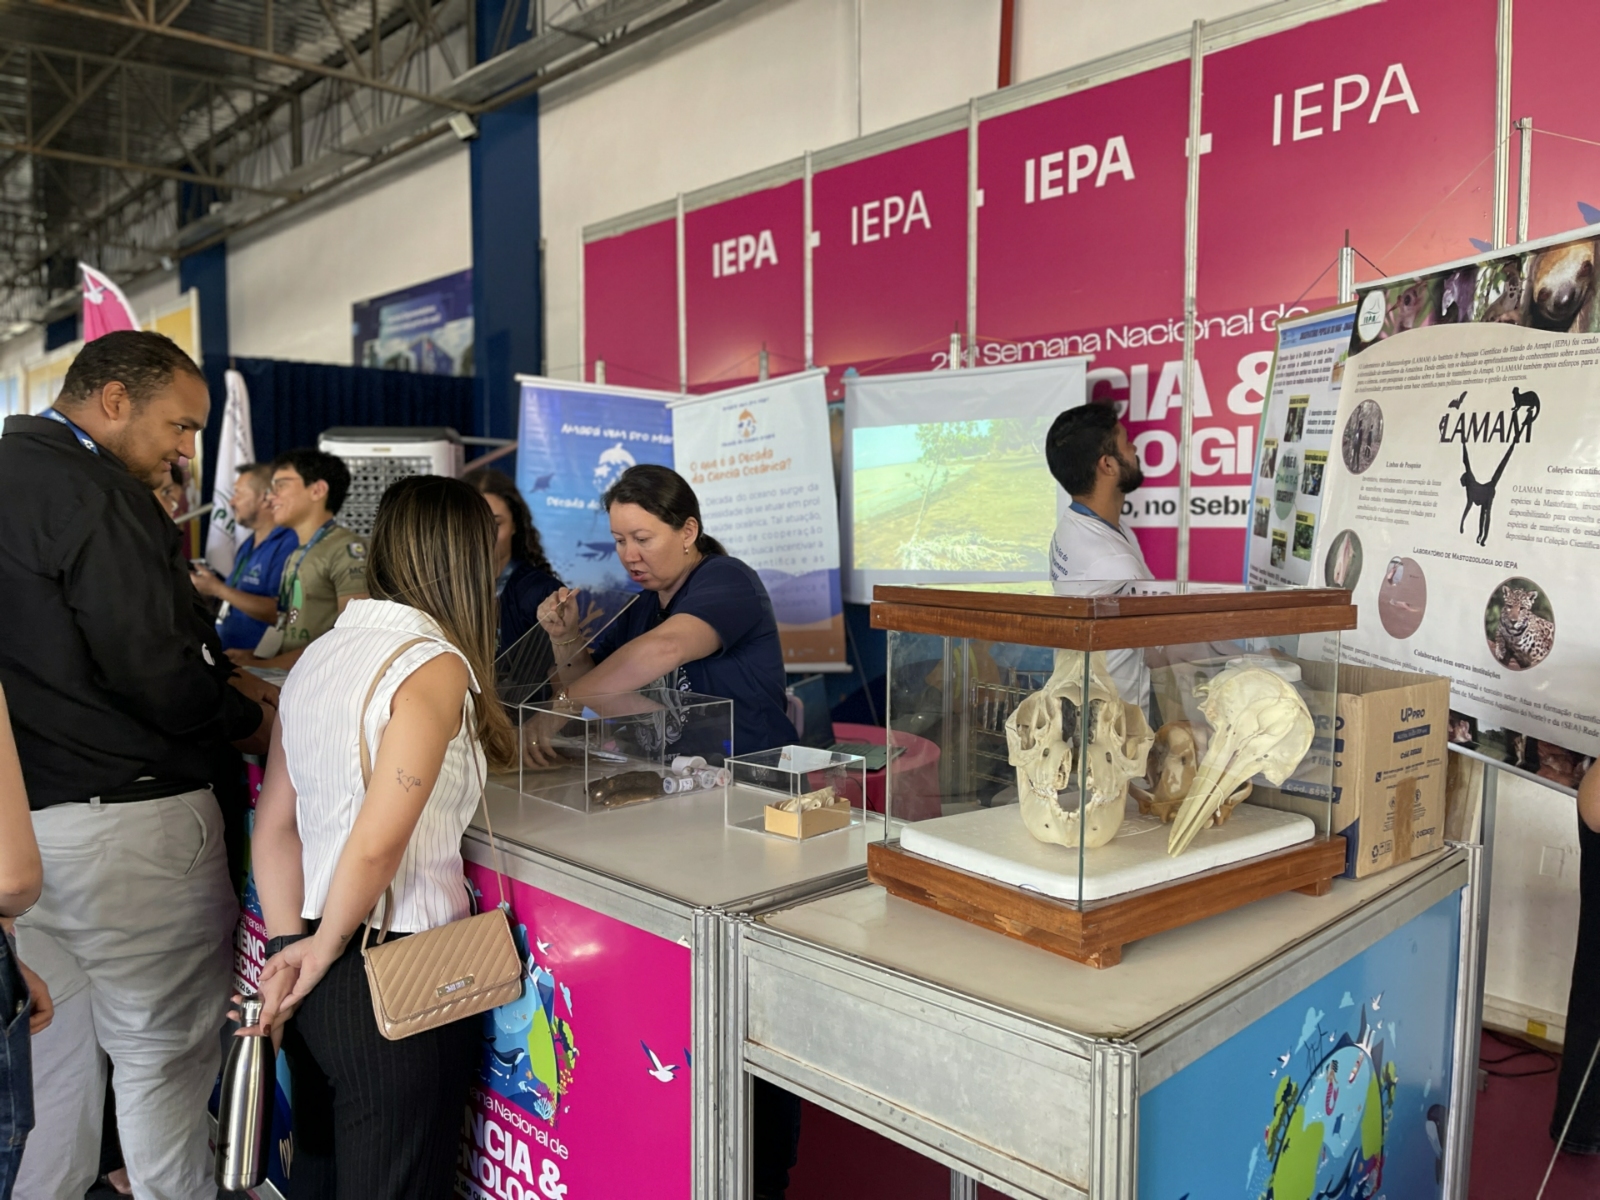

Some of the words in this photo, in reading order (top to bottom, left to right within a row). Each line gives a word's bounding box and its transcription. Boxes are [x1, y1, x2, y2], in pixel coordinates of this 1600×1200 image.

[1272, 63, 1419, 146] IEPA
[1025, 135, 1135, 204] IEPA
[851, 190, 931, 246] IEPA
[712, 230, 778, 278] IEPA
[983, 332, 1101, 365] Semana
[1106, 307, 1255, 351] Nacional
[1552, 340, 1570, 349] (IEPA)
[1581, 336, 1598, 344] criado
[1560, 349, 1574, 357] sobre
[1501, 364, 1522, 372] LAMAM
[1580, 359, 1594, 368] para
[1087, 359, 1213, 422] CIA
[1439, 410, 1533, 443] LAMAM
[743, 458, 792, 477] Oceânica?
[1546, 465, 1574, 475] Coleções
[736, 492, 748, 502] do
[749, 490, 777, 500] oceano
[780, 486, 804, 497] surge
[807, 482, 819, 492] da
[1512, 484, 1518, 492] O
[1518, 485, 1543, 494] LAMAM
[764, 502, 785, 512] atuar
[787, 499, 802, 508] em
[803, 496, 820, 508] prol
[1146, 500, 1176, 516] no
[1190, 495, 1251, 515] Sebr
[771, 514, 783, 525] Tal
[785, 511, 822, 525] atuação,
[1552, 514, 1566, 522] para
[747, 531, 758, 541] de
[762, 526, 823, 540] cooperação
[1572, 526, 1582, 534] do
[776, 542, 817, 554] incentivar
[1544, 536, 1568, 546] Coleção
[1569, 538, 1600, 550] Científica
[801, 556, 808, 564] e
[816, 554, 825, 564] as
[1504, 560, 1518, 570] IEPA
[1414, 648, 1442, 662] Colaboração
[1443, 658, 1454, 666] com
[1454, 662, 1471, 671] outras
[1472, 664, 1501, 680] instituições
[1543, 703, 1572, 717] formação
[1561, 720, 1582, 734] (SEA)
[1583, 726, 1600, 738] Rede
[1286, 783, 1306, 794] Cód.
[494, 1099, 548, 1147] Nacional
[550, 1138, 568, 1160] de
[464, 1103, 534, 1186] NCIA
[538, 1158, 569, 1200] &
